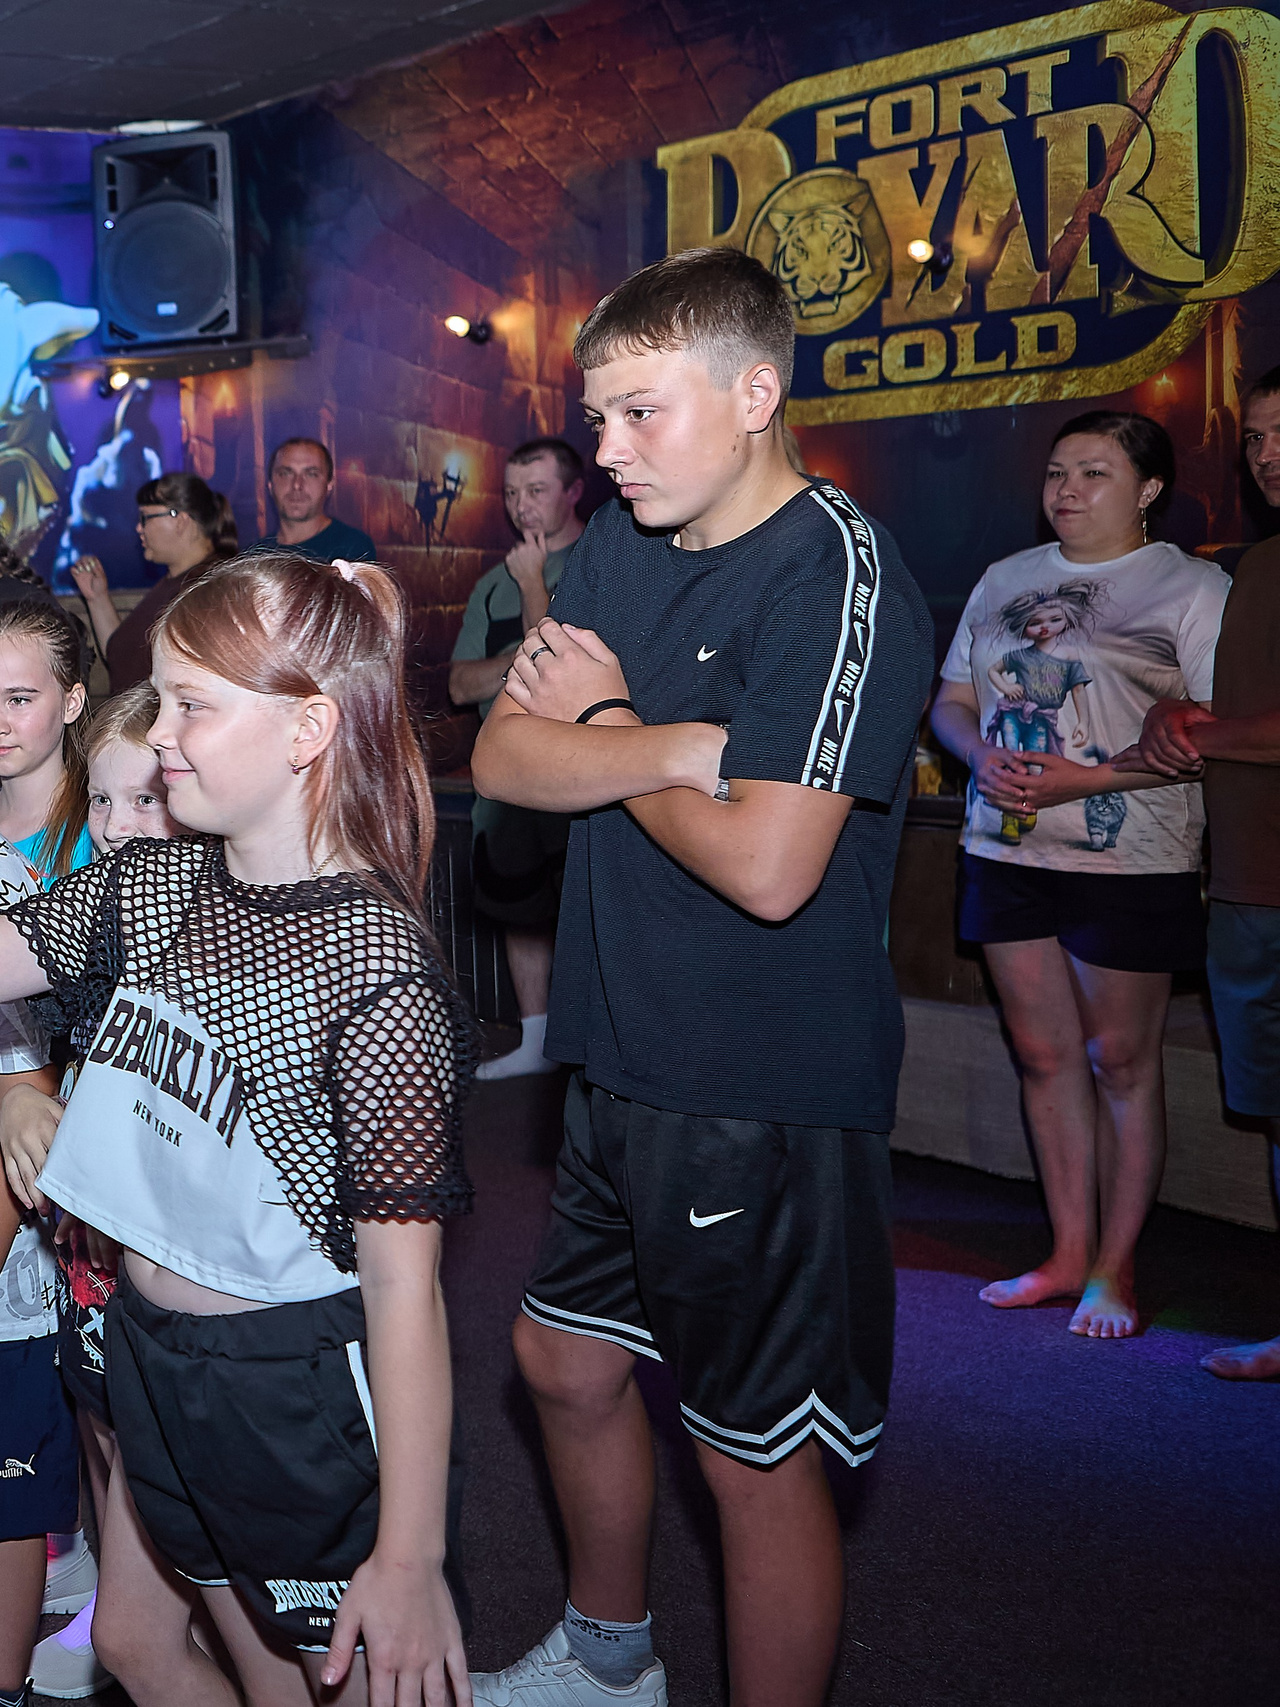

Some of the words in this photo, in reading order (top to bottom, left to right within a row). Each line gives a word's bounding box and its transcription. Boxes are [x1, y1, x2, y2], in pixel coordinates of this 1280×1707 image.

[816, 50, 1070, 164] FORT
[823, 311, 1077, 390] GOLD
[847, 518, 870, 546] NIKE
[853, 582, 871, 621] NIKE
[837, 659, 862, 698] NIKE
[820, 737, 838, 774] NIKE
[132, 1099, 152, 1125] NEW
[154, 1116, 182, 1147] YORK
[265, 1579, 350, 1613] BROOKL
[309, 1617, 330, 1627] NEW
[571, 1619, 621, 1642] adidas
